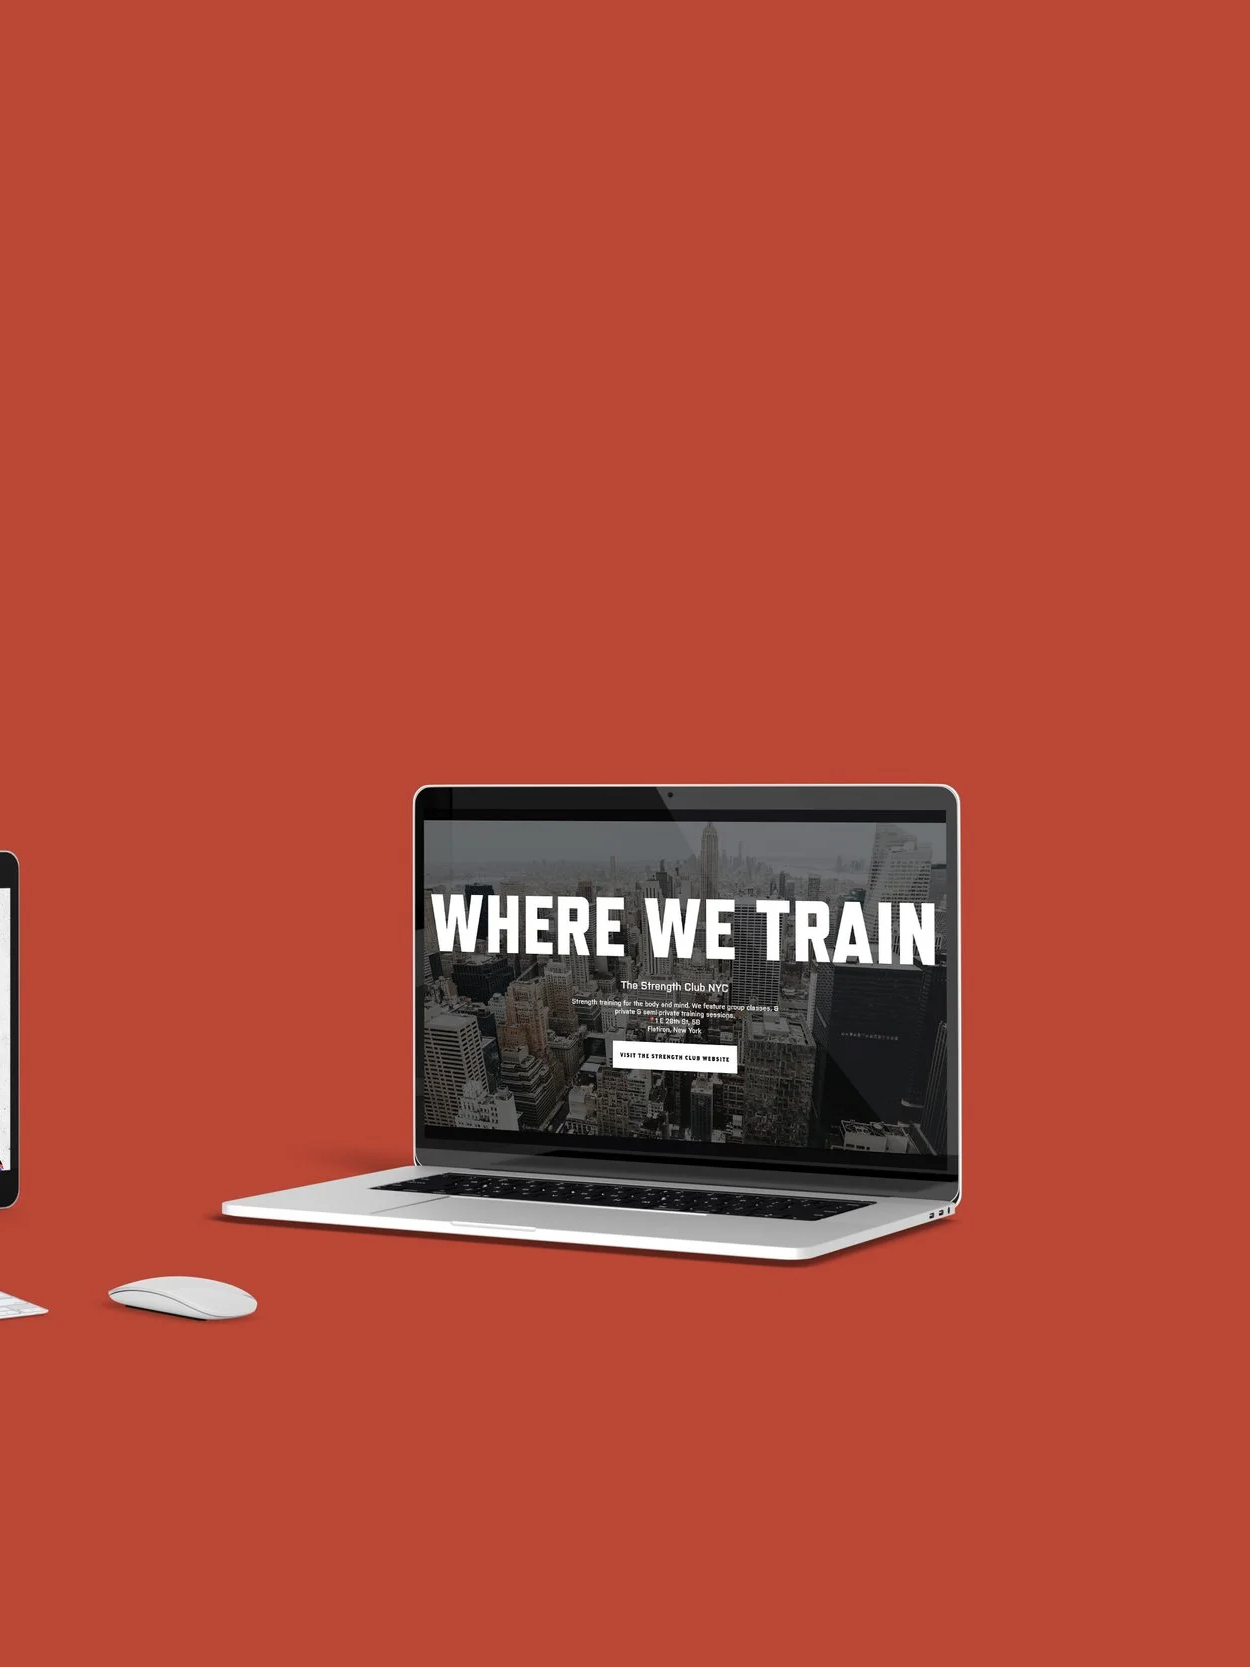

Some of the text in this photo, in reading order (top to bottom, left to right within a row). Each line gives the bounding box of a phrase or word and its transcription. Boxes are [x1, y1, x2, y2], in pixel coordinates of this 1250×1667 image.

[432, 895, 934, 965] WHERE WE TRAIN
[620, 980, 729, 992] The Strength Club NYC
[571, 998, 598, 1007] Strength
[598, 999, 622, 1007] training
